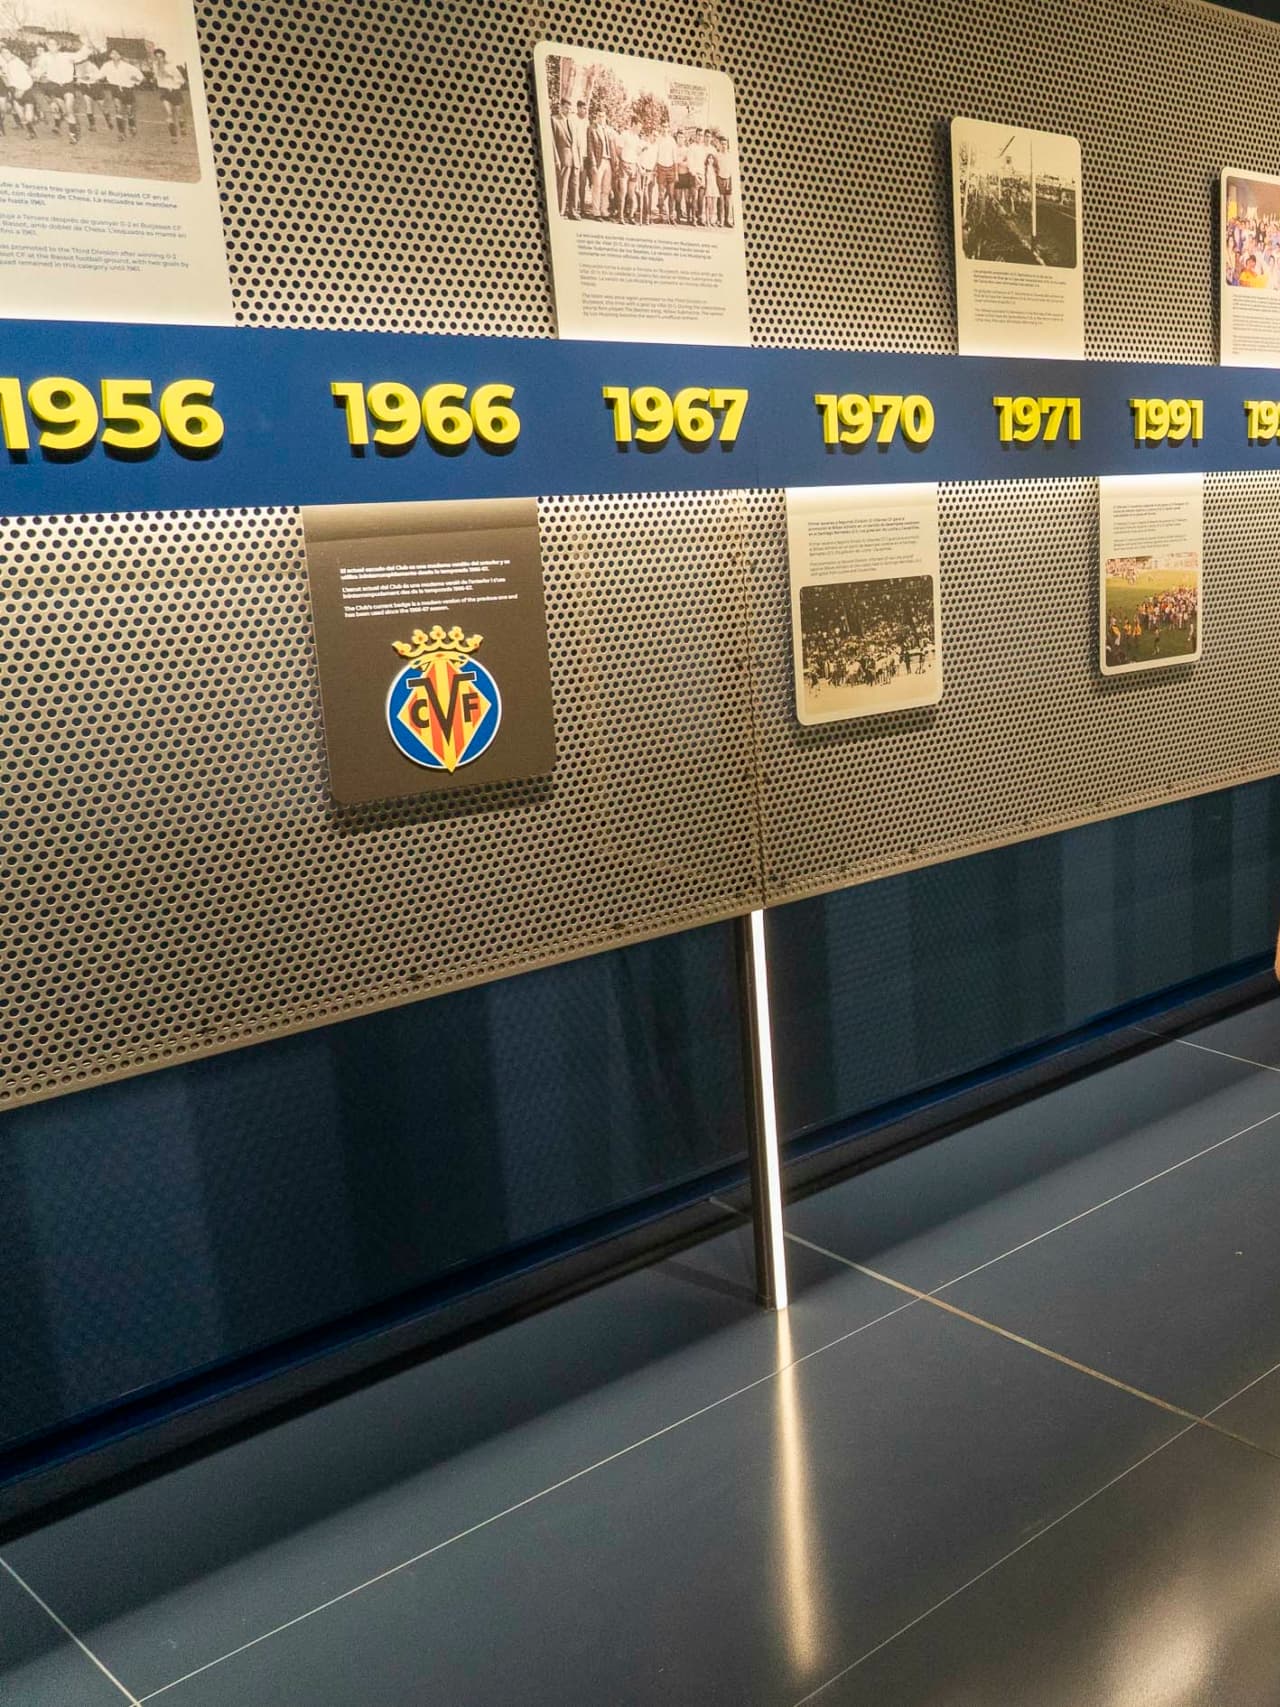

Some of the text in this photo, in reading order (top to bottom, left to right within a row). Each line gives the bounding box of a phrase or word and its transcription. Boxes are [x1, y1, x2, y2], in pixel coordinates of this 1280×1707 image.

[0, 378, 223, 449] 1956
[331, 382, 520, 446] 1966
[602, 387, 747, 443] 1967
[814, 394, 934, 445] 1970
[993, 396, 1081, 442] 1971
[1130, 398, 1203, 440] 1991
